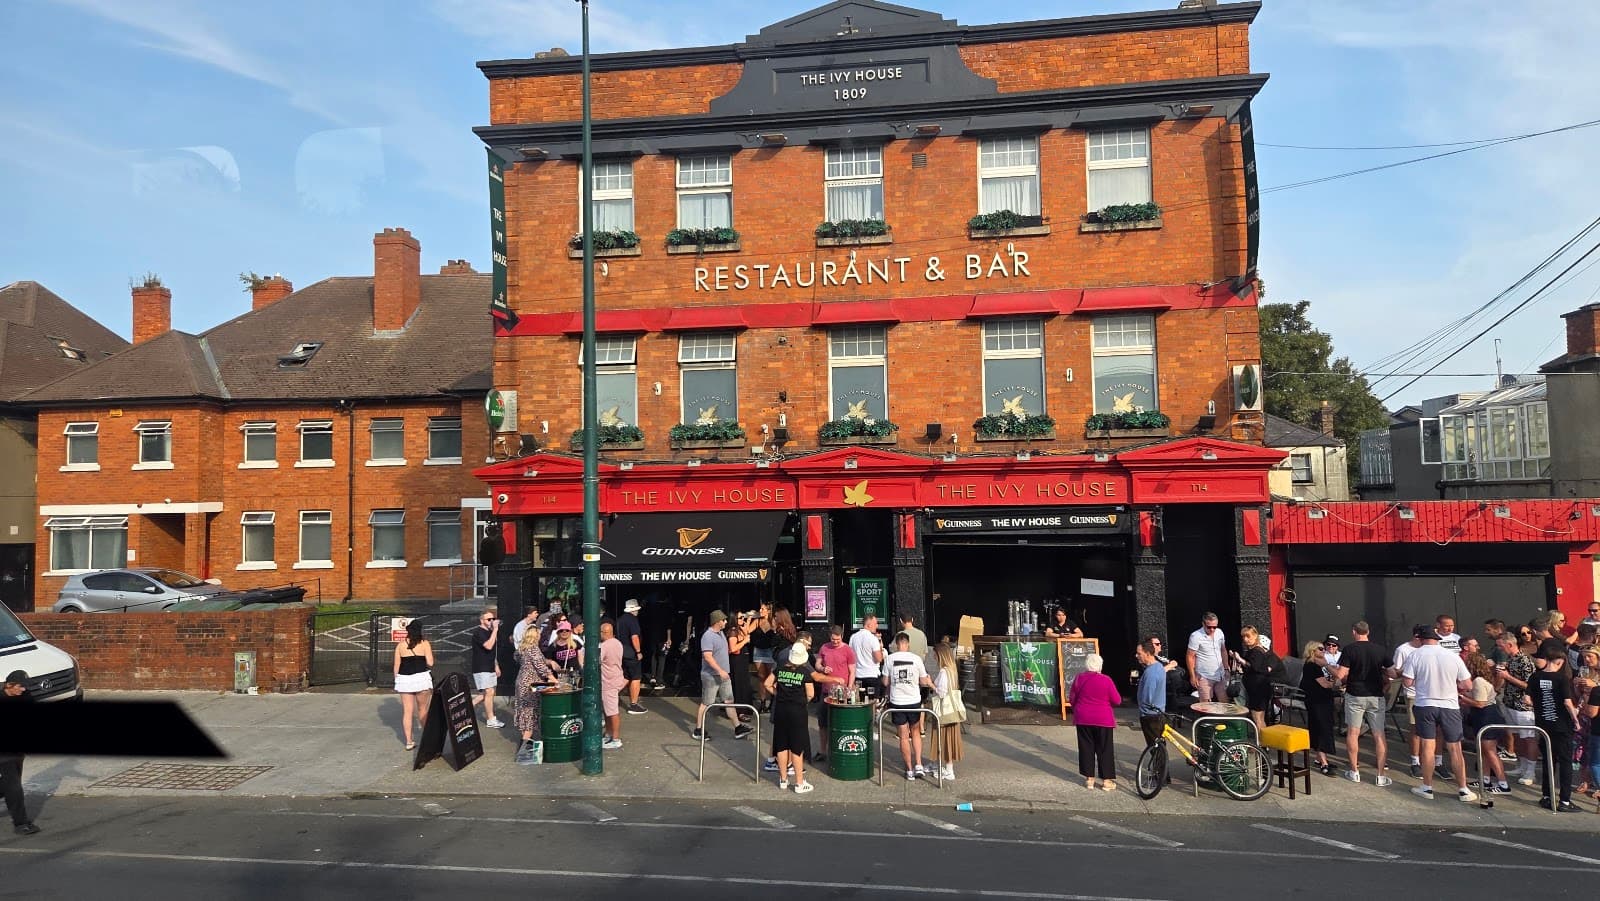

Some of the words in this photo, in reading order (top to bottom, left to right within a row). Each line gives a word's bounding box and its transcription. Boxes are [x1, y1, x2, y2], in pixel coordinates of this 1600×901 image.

[801, 74, 825, 85] THE
[830, 72, 850, 82] IVY
[855, 67, 902, 80] HOUSE
[834, 88, 867, 99] 1809
[493, 207, 503, 222] THE
[694, 256, 911, 291] RESTAURANT
[925, 256, 945, 281] &
[965, 251, 1031, 279] BAR
[1128, 383, 1150, 394] HOUSE
[936, 484, 977, 498] THE
[988, 483, 1025, 498] IVY
[1036, 482, 1116, 497] HOUSE
[1191, 483, 1207, 492] 114
[621, 491, 658, 505] THE
[668, 490, 703, 504] IVY
[714, 488, 785, 503] HOUSE
[944, 519, 982, 528] GUINNESS
[992, 519, 1010, 527] THE
[1012, 518, 1026, 527] IVY
[1028, 517, 1061, 526] HOUSE
[1069, 515, 1108, 524] GUINNESS
[641, 547, 725, 556] GUINNESS
[599, 573, 633, 581] UINNESS
[640, 572, 660, 581] THE
[662, 571, 676, 581] IVY
[678, 571, 711, 581] HOUSE
[717, 570, 758, 579] GUINNESS
[1031, 658, 1055, 666] HOUSE
[1004, 682, 1054, 696] Heineken
